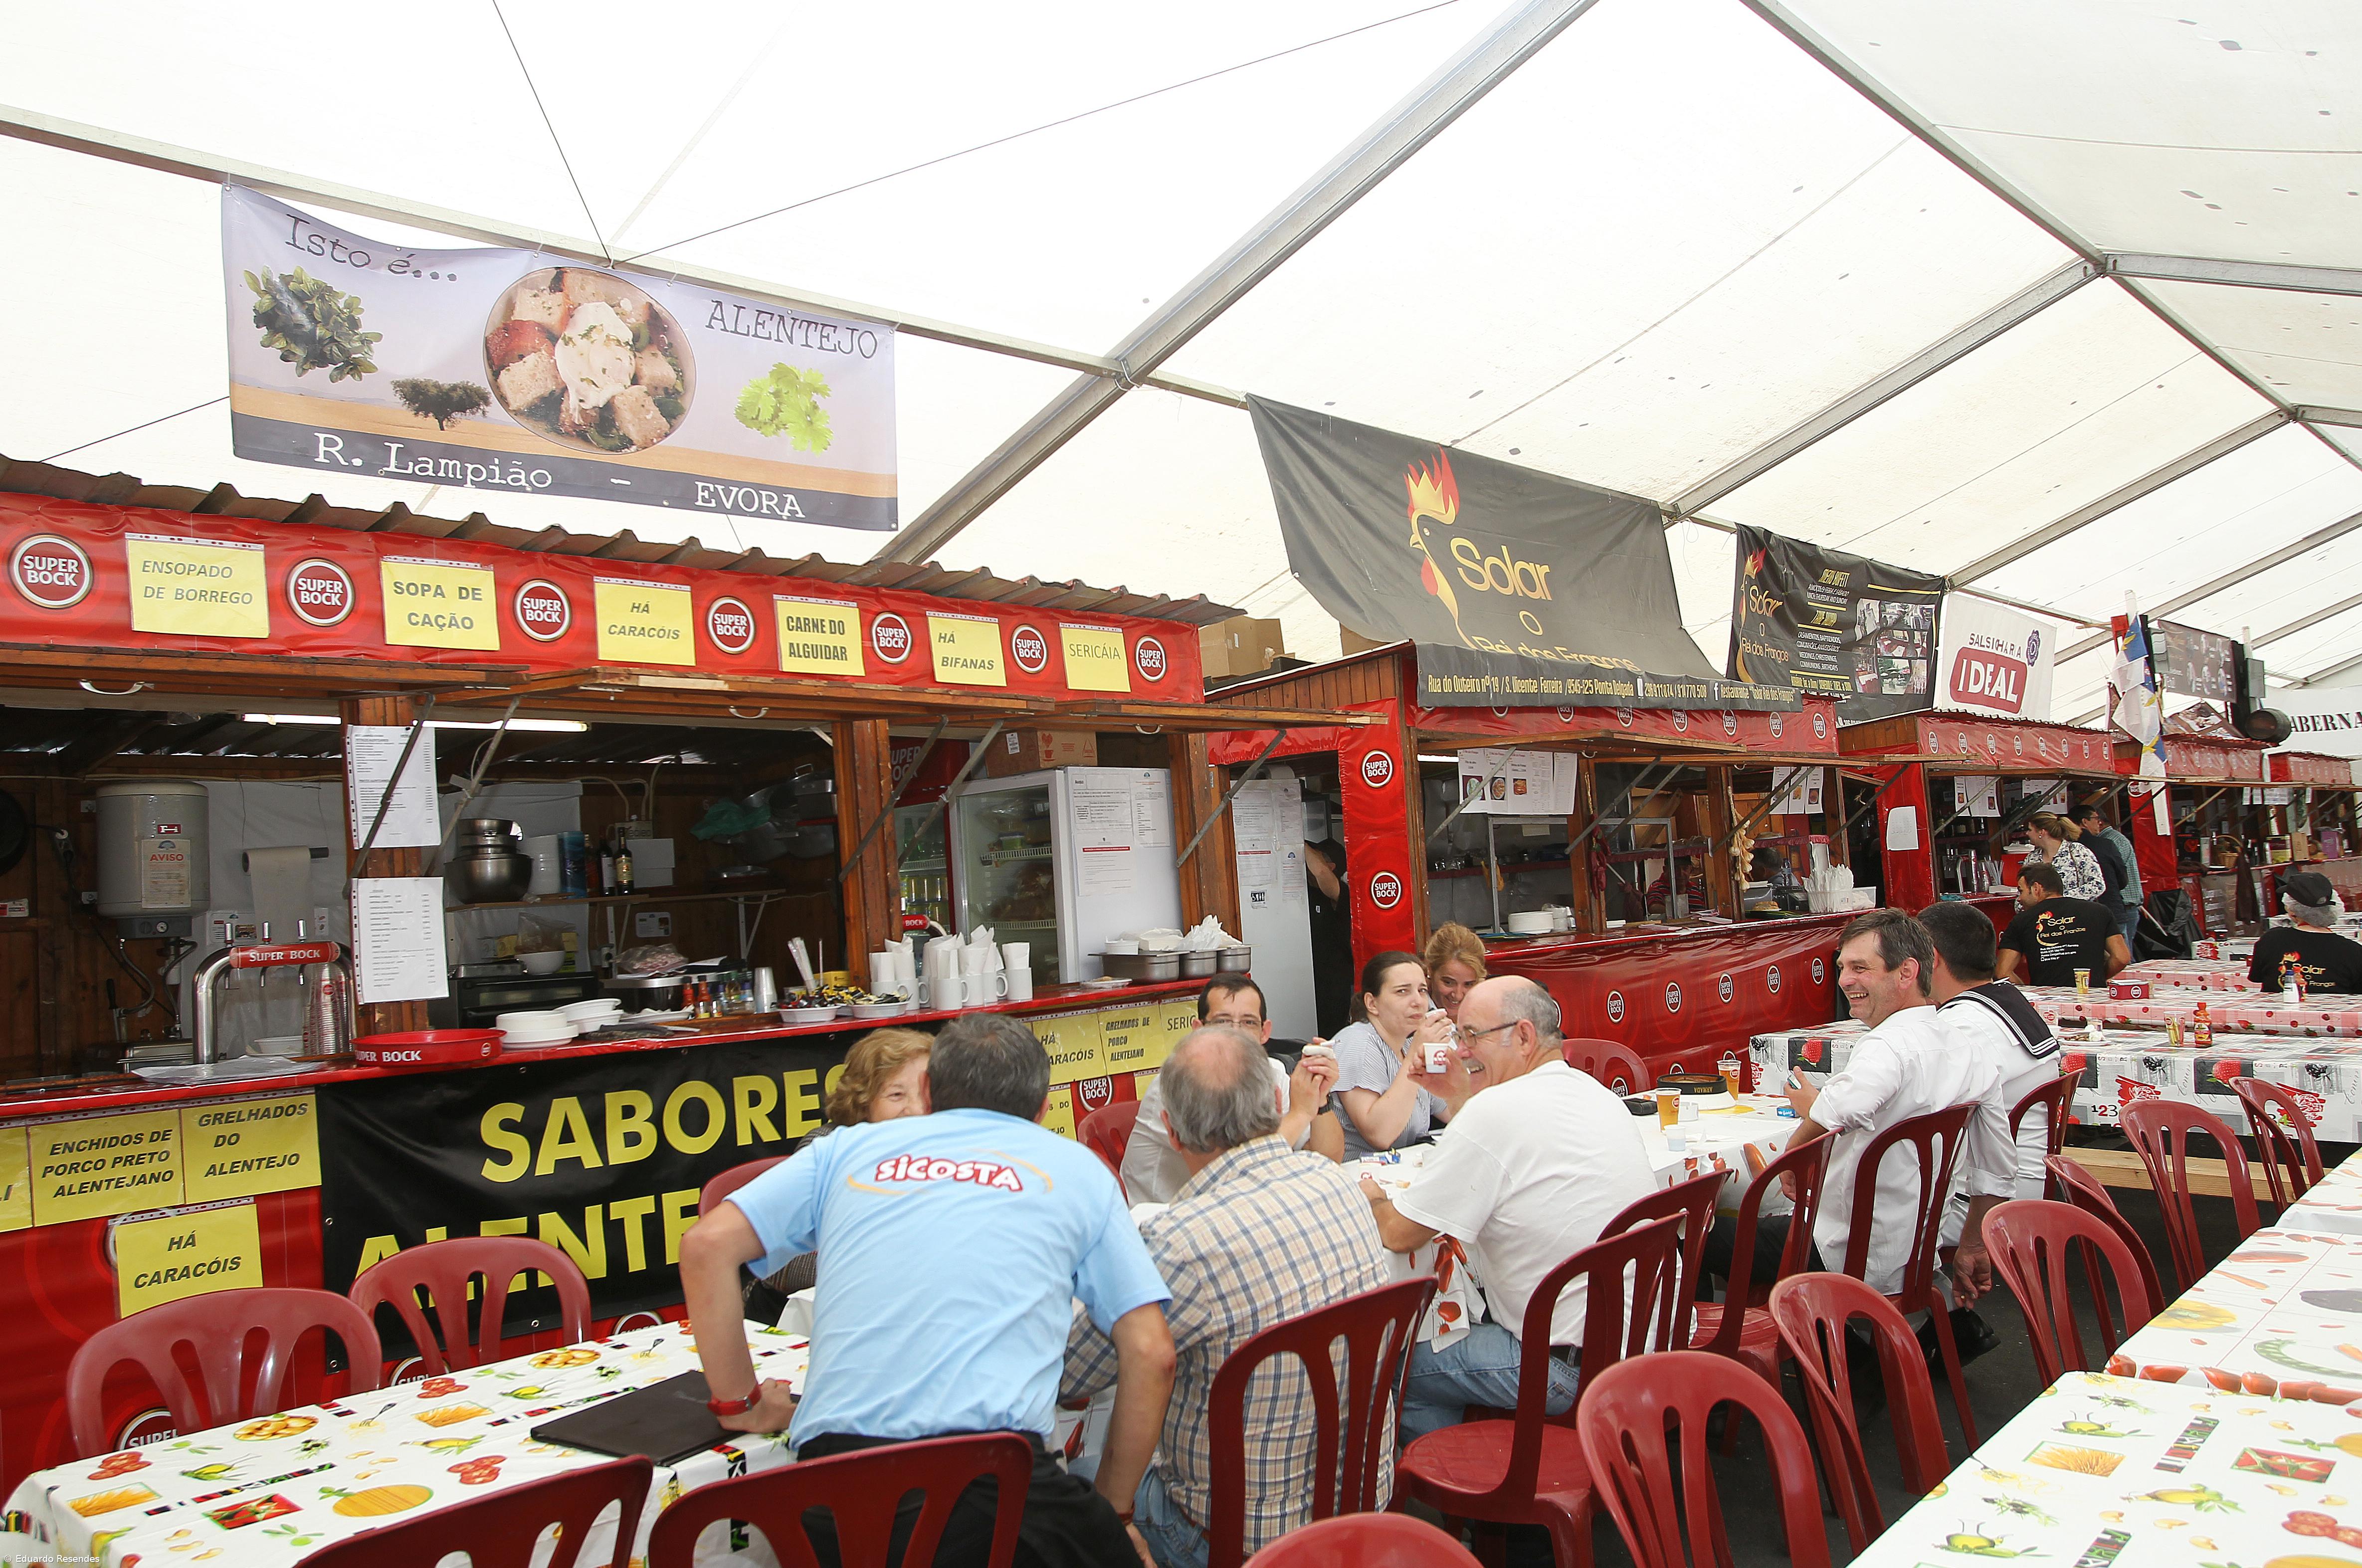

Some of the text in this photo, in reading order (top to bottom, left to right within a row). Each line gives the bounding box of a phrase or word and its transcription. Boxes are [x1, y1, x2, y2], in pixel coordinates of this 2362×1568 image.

[285, 214, 458, 282] Isto é...
[705, 300, 878, 359] ALENTEJO
[314, 432, 364, 467] R.
[384, 442, 553, 489] Lampião
[695, 481, 805, 519] EVORA
[23, 555, 79, 574] SUPER
[142, 560, 233, 580] ENSOPADO
[1450, 537, 1553, 600] Solar
[27, 570, 78, 588] BOCK
[298, 577, 344, 595] SUPER
[143, 585, 253, 605] DE BORREGO
[300, 590, 343, 607] BOCK
[393, 581, 483, 601] SOPA DE
[523, 597, 562, 614] SUPER
[629, 600, 650, 614] HÁ
[407, 612, 474, 632] CAÇÃO
[525, 609, 562, 623] BOCK
[714, 612, 747, 628] SUPER
[1518, 610, 1544, 636] O
[607, 622, 681, 640] CARACÓIS
[716, 624, 747, 638] BOCK
[786, 615, 846, 635] CARNE DO
[876, 626, 906, 640] SUPER
[937, 630, 956, 644] HÁ
[878, 636, 905, 649] BOCK
[1016, 637, 1042, 651] SUPER
[788, 642, 848, 662] ALGUIDAR
[1018, 647, 1041, 659] BOCK
[1069, 641, 1122, 660] SERICÁIA
[1139, 647, 1162, 661] SUPER
[1742, 638, 1789, 663] Rei dos Frangos
[941, 656, 995, 671] BIFANAS
[1141, 657, 1162, 669] BOCK
[1428, 674, 1441, 693] Rua
[1443, 674, 1452, 693] do
[1453, 675, 1481, 693] Outeiro
[1491, 676, 1499, 693] 19
[1505, 676, 1512, 693] S.
[1512, 676, 1538, 693] Vicente
[1540, 676, 1562, 693] Ferreira
[1595, 679, 1612, 695] Ponta
[1613, 680, 1634, 698] Delgada
[1721, 684, 1750, 699] Restaurante
[1957, 658, 2019, 704] IDEAL
[892, 746, 922, 765] UPER
[892, 765, 919, 781] OCK
[1366, 760, 1388, 771] SUPER
[1367, 768, 1388, 778] BOCK
[149, 853, 184, 862] AVISO
[1375, 882, 1397, 891] SUPER
[905, 918, 924, 927] BOCK
[2047, 917, 2075, 926] Solar
[249, 949, 321, 963] SUPER BOCK
[1813, 965, 1823, 973] SUPER
[1768, 973, 1778, 981] SUPER
[1720, 980, 1731, 990] SUPER
[1721, 987, 1731, 995] BOCK
[1667, 990, 1680, 999] SUPER
[1668, 996, 1680, 1004] BOCK
[1609, 998, 1623, 1009] SUPER
[1610, 1005, 1622, 1014] BOCK
[1106, 1016, 1150, 1031] GRELHADOS DE
[1108, 1036, 1128, 1047] PORCO
[382, 1050, 422, 1062] BOCK
[1048, 1048, 1094, 1066] ARACÓIS
[1110, 1048, 1145, 1062] ALENTEJANO
[1083, 1079, 1108, 1091] SUPER
[1085, 1087, 1108, 1100] BOCK
[198, 1103, 309, 1127] GRELHADOS
[49, 1130, 174, 1156] ENCHIDOS DE
[214, 1133, 241, 1148] DO
[42, 1150, 171, 1178] PORCO PRETO
[204, 1153, 300, 1177] ALENTEJO
[53, 1170, 175, 1198] ALENTEJANO
[167, 1230, 197, 1252] HÁ
[134, 1255, 242, 1289] CARACÓIS
